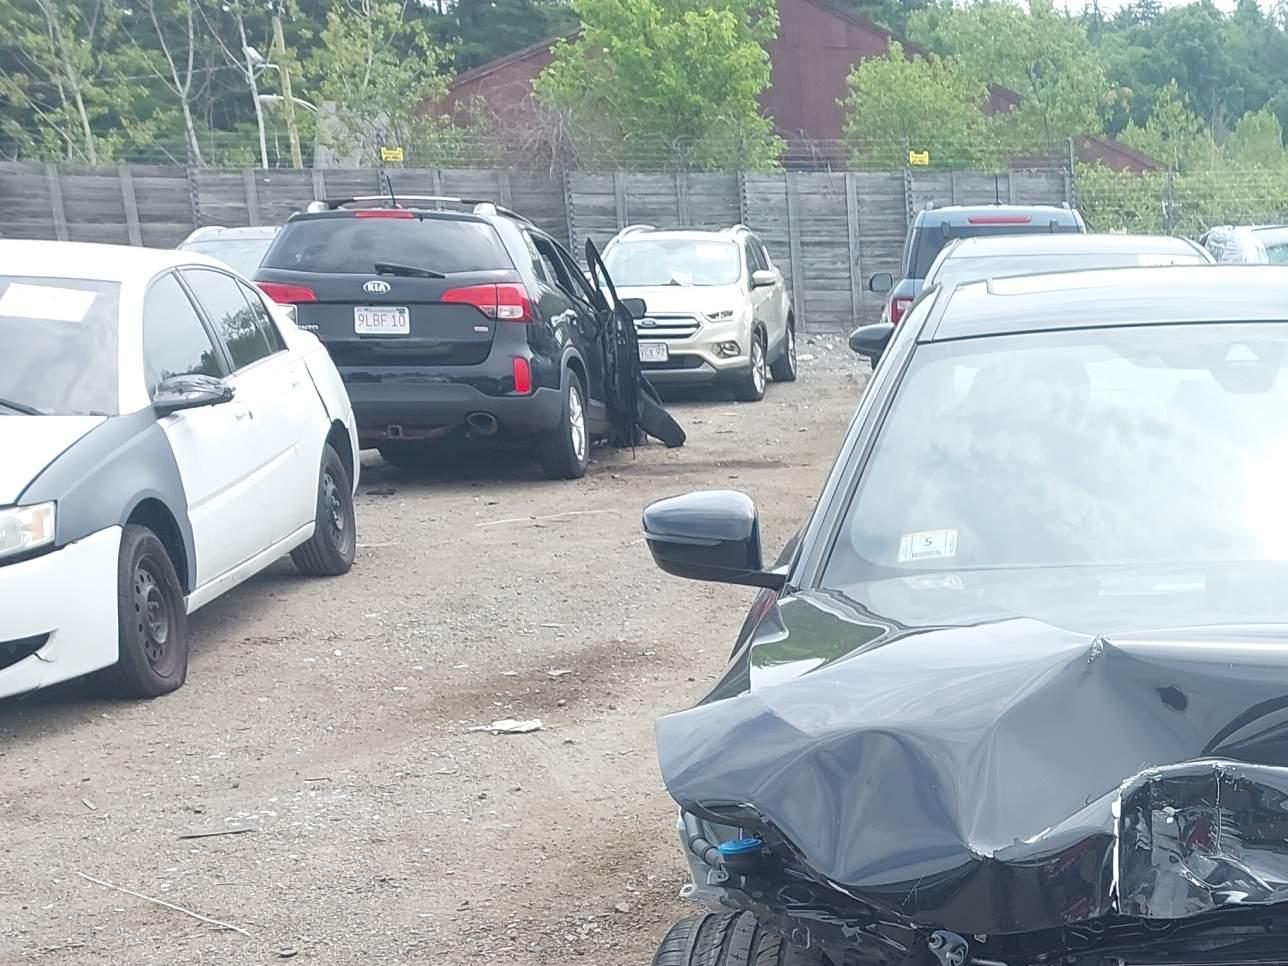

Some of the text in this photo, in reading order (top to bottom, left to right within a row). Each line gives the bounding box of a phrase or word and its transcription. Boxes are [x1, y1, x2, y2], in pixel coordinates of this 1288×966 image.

[367, 283, 386, 292] KIA
[358, 313, 406, 327] 9LBF 10
